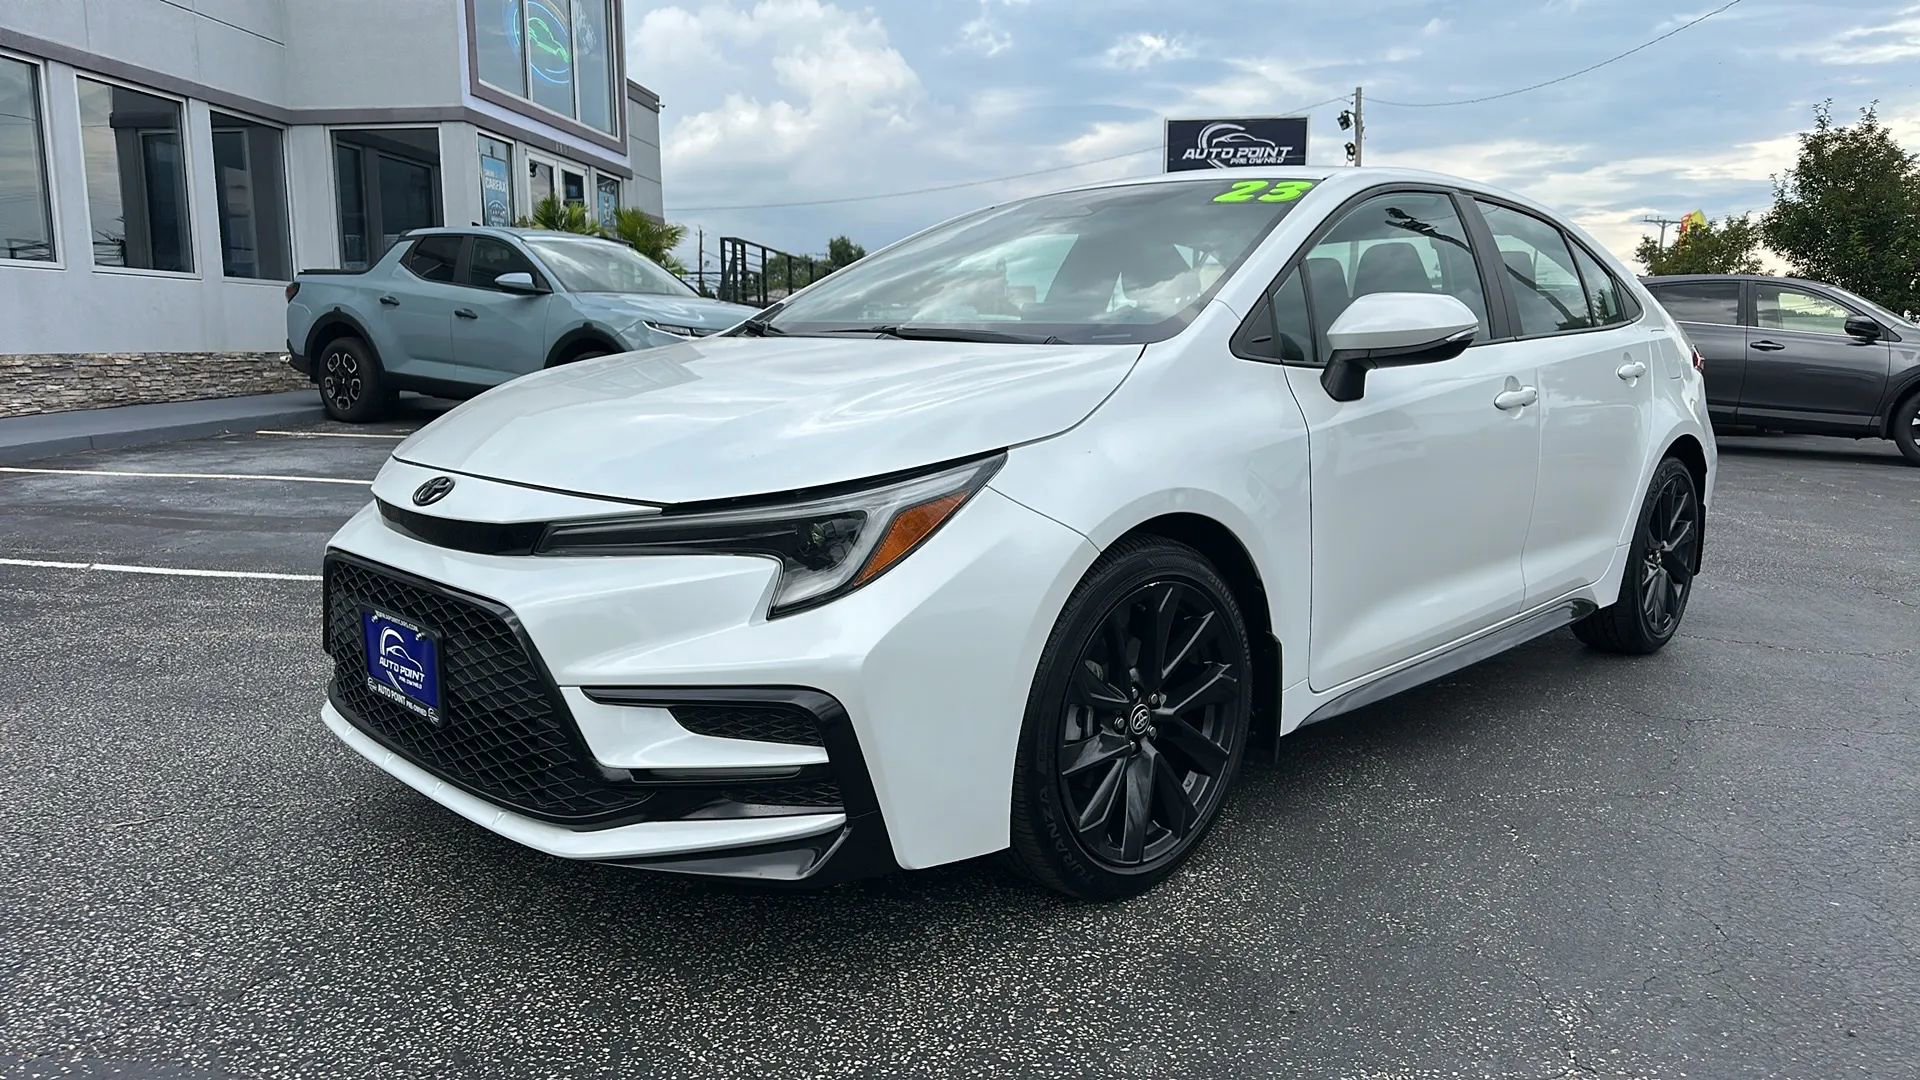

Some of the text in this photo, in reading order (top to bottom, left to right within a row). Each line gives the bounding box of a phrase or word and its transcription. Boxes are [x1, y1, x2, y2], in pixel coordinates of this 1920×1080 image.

[1182, 146, 1293, 160] AUTO POINT
[1213, 180, 1313, 203] 23
[379, 657, 425, 682] AUTO POINT
[378, 684, 391, 698] AUTO
[391, 690, 406, 706] POINT
